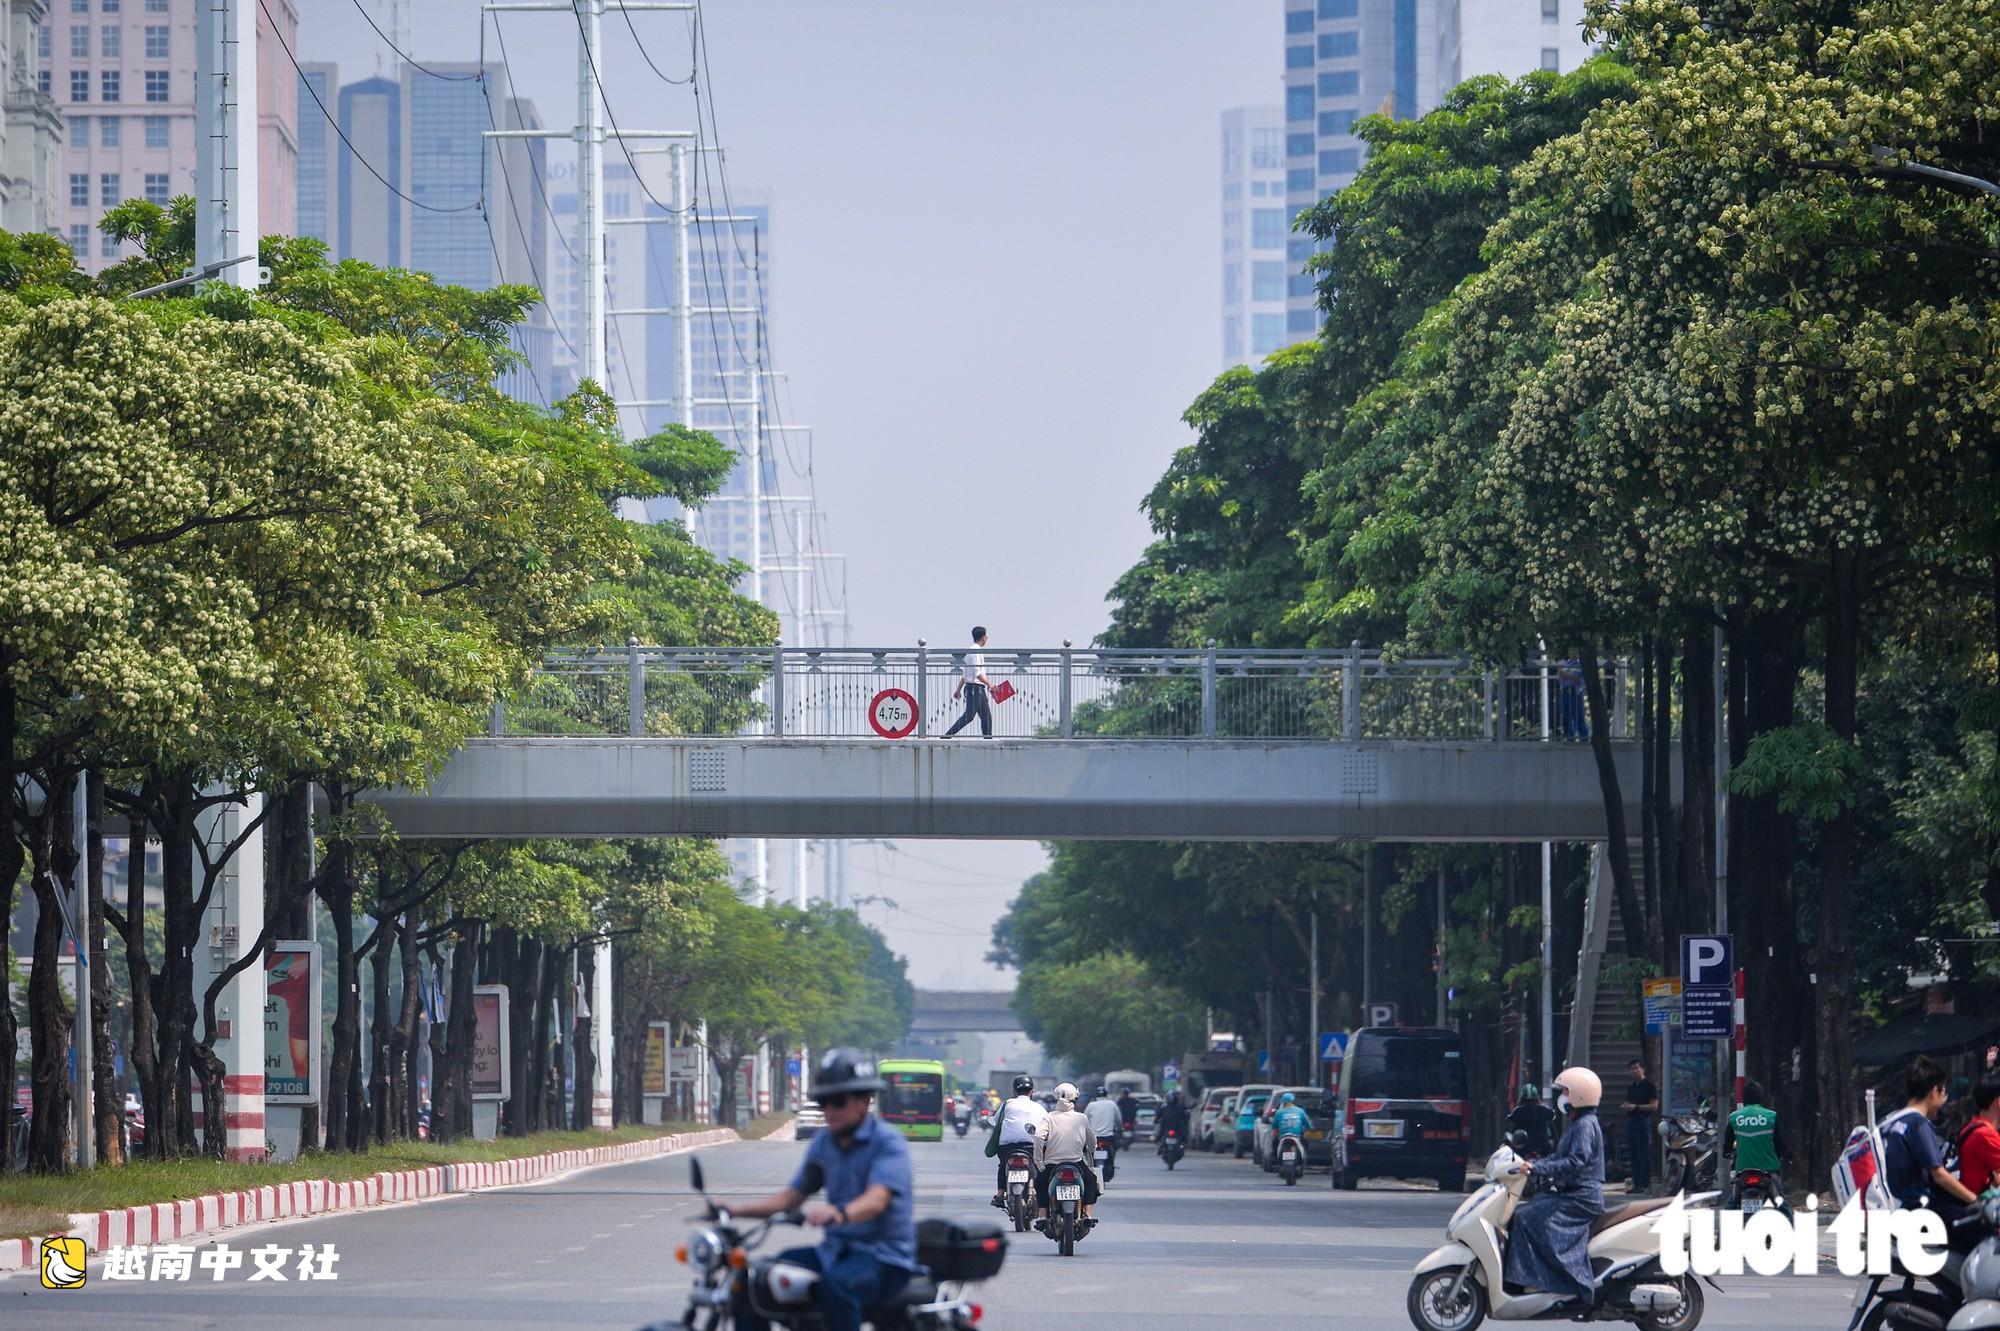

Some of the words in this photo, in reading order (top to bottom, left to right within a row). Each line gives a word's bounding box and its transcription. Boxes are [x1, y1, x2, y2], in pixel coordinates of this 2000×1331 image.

[1689, 938, 1725, 983] P
[1371, 1006, 1392, 1027] P
[284, 1082, 303, 1093] 108
[1736, 1114, 1767, 1126] Grab
